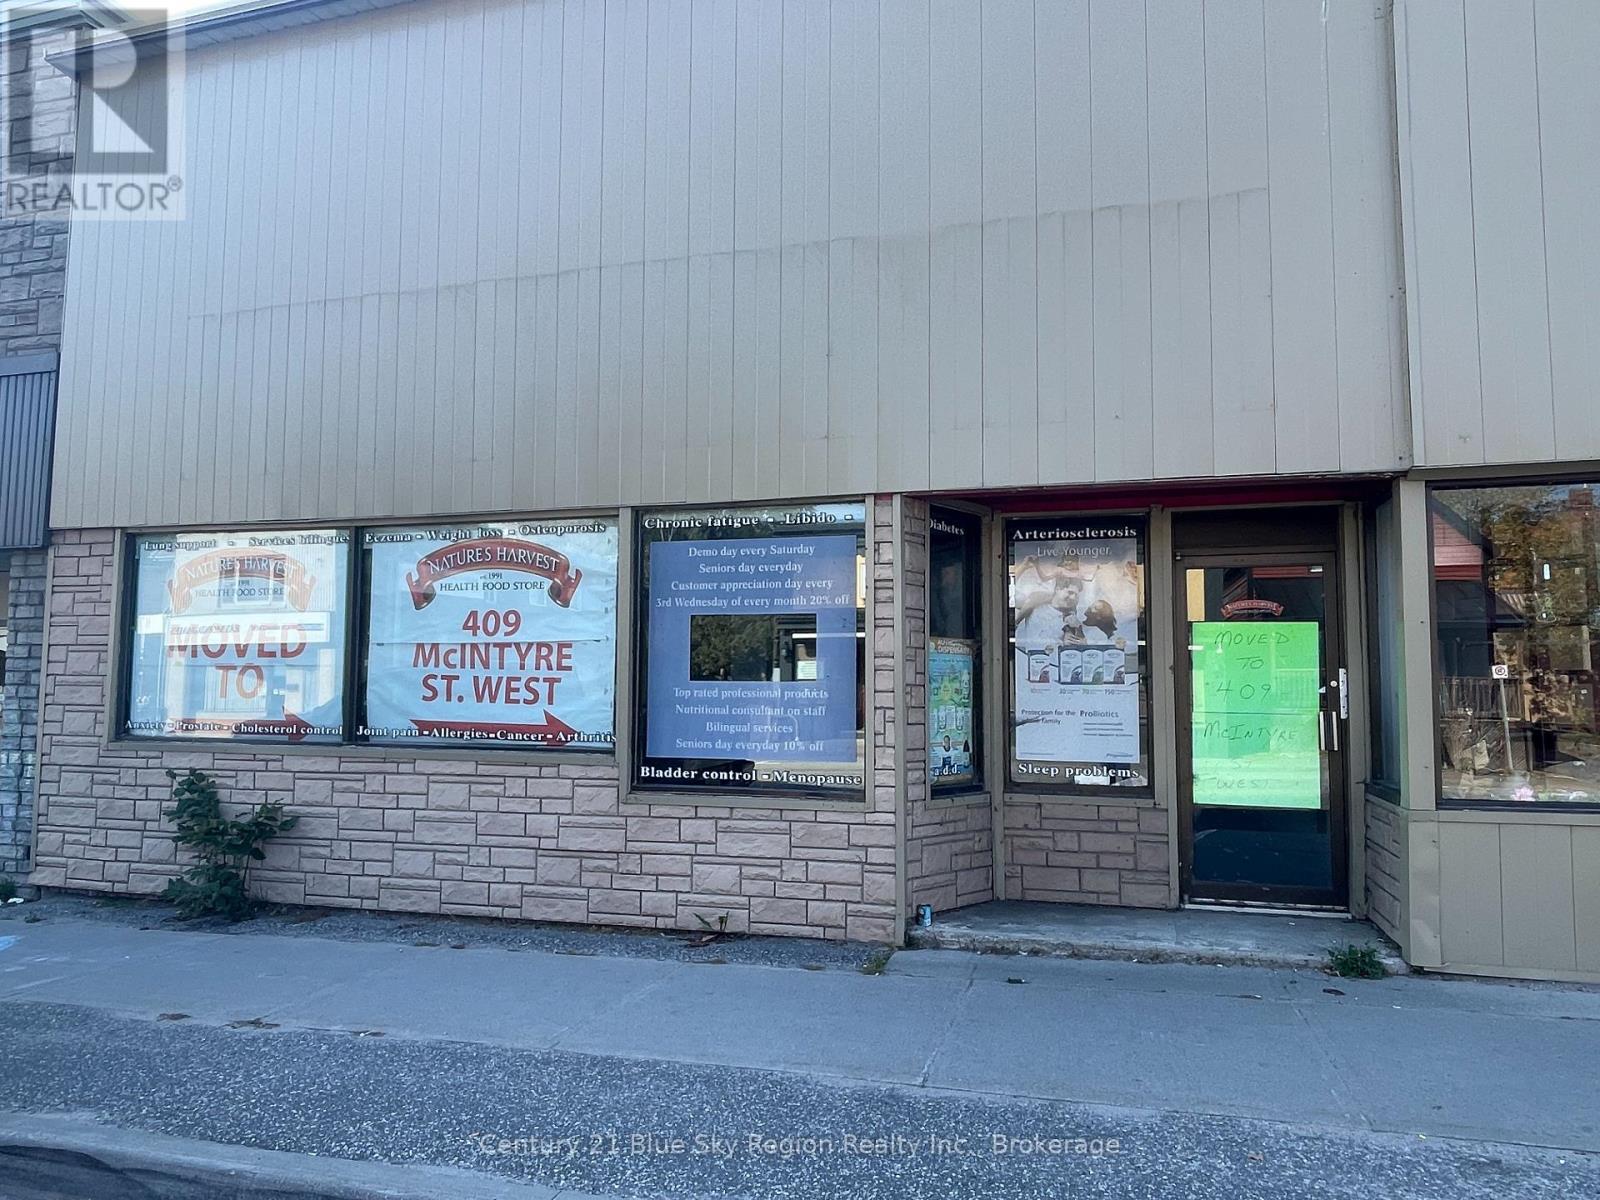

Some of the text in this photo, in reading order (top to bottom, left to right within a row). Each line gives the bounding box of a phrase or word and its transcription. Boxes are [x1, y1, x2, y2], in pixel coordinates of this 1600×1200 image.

[644, 515, 702, 529] Chronic
[707, 515, 758, 529] fatigue
[785, 512, 835, 524] Libido
[929, 518, 965, 536] Diabetes
[365, 533, 411, 543] Eczema
[425, 530, 471, 542] Weight
[478, 528, 502, 538] loss
[519, 522, 606, 536] Osteoporosis
[1013, 526, 1137, 540] Arteriosclerosis
[144, 540, 172, 551] Lung
[174, 539, 216, 550] support
[689, 543, 815, 559] Demo day every Saturday
[1037, 547, 1058, 557] Live
[497, 546, 560, 572] HARVEST
[699, 561, 803, 574] Seniors day everyday
[440, 580, 545, 592] HEALTH FOOD STORE
[671, 578, 833, 593] Customer appreciation day every
[656, 594, 849, 609] 3rd Wednesday of every month 20% off
[462, 609, 521, 637] 409
[168, 624, 307, 659] MOVED
[1214, 630, 1290, 646] MOVED
[413, 642, 573, 672] McINTYRE
[1236, 656, 1265, 669] TO
[215, 663, 264, 699] TO
[422, 674, 562, 706] ST. WEST
[673, 687, 829, 700] Top rated professional products
[675, 704, 826, 716] Nutritional consultant on staff
[175, 721, 221, 732] Prostate
[232, 722, 297, 734] Cholesterol
[301, 725, 343, 736] control
[356, 725, 389, 736] Joint
[392, 727, 419, 740] pain
[556, 731, 617, 742] Arthritis
[706, 722, 793, 734] Bilingual services
[676, 738, 824, 752] Seniors day everyday 10% off
[640, 766, 698, 779] Bladder
[702, 768, 756, 781] control
[773, 770, 862, 786] Menopause
[934, 764, 961, 776] a.d.d.
[1018, 763, 1139, 779] Sleep problems
